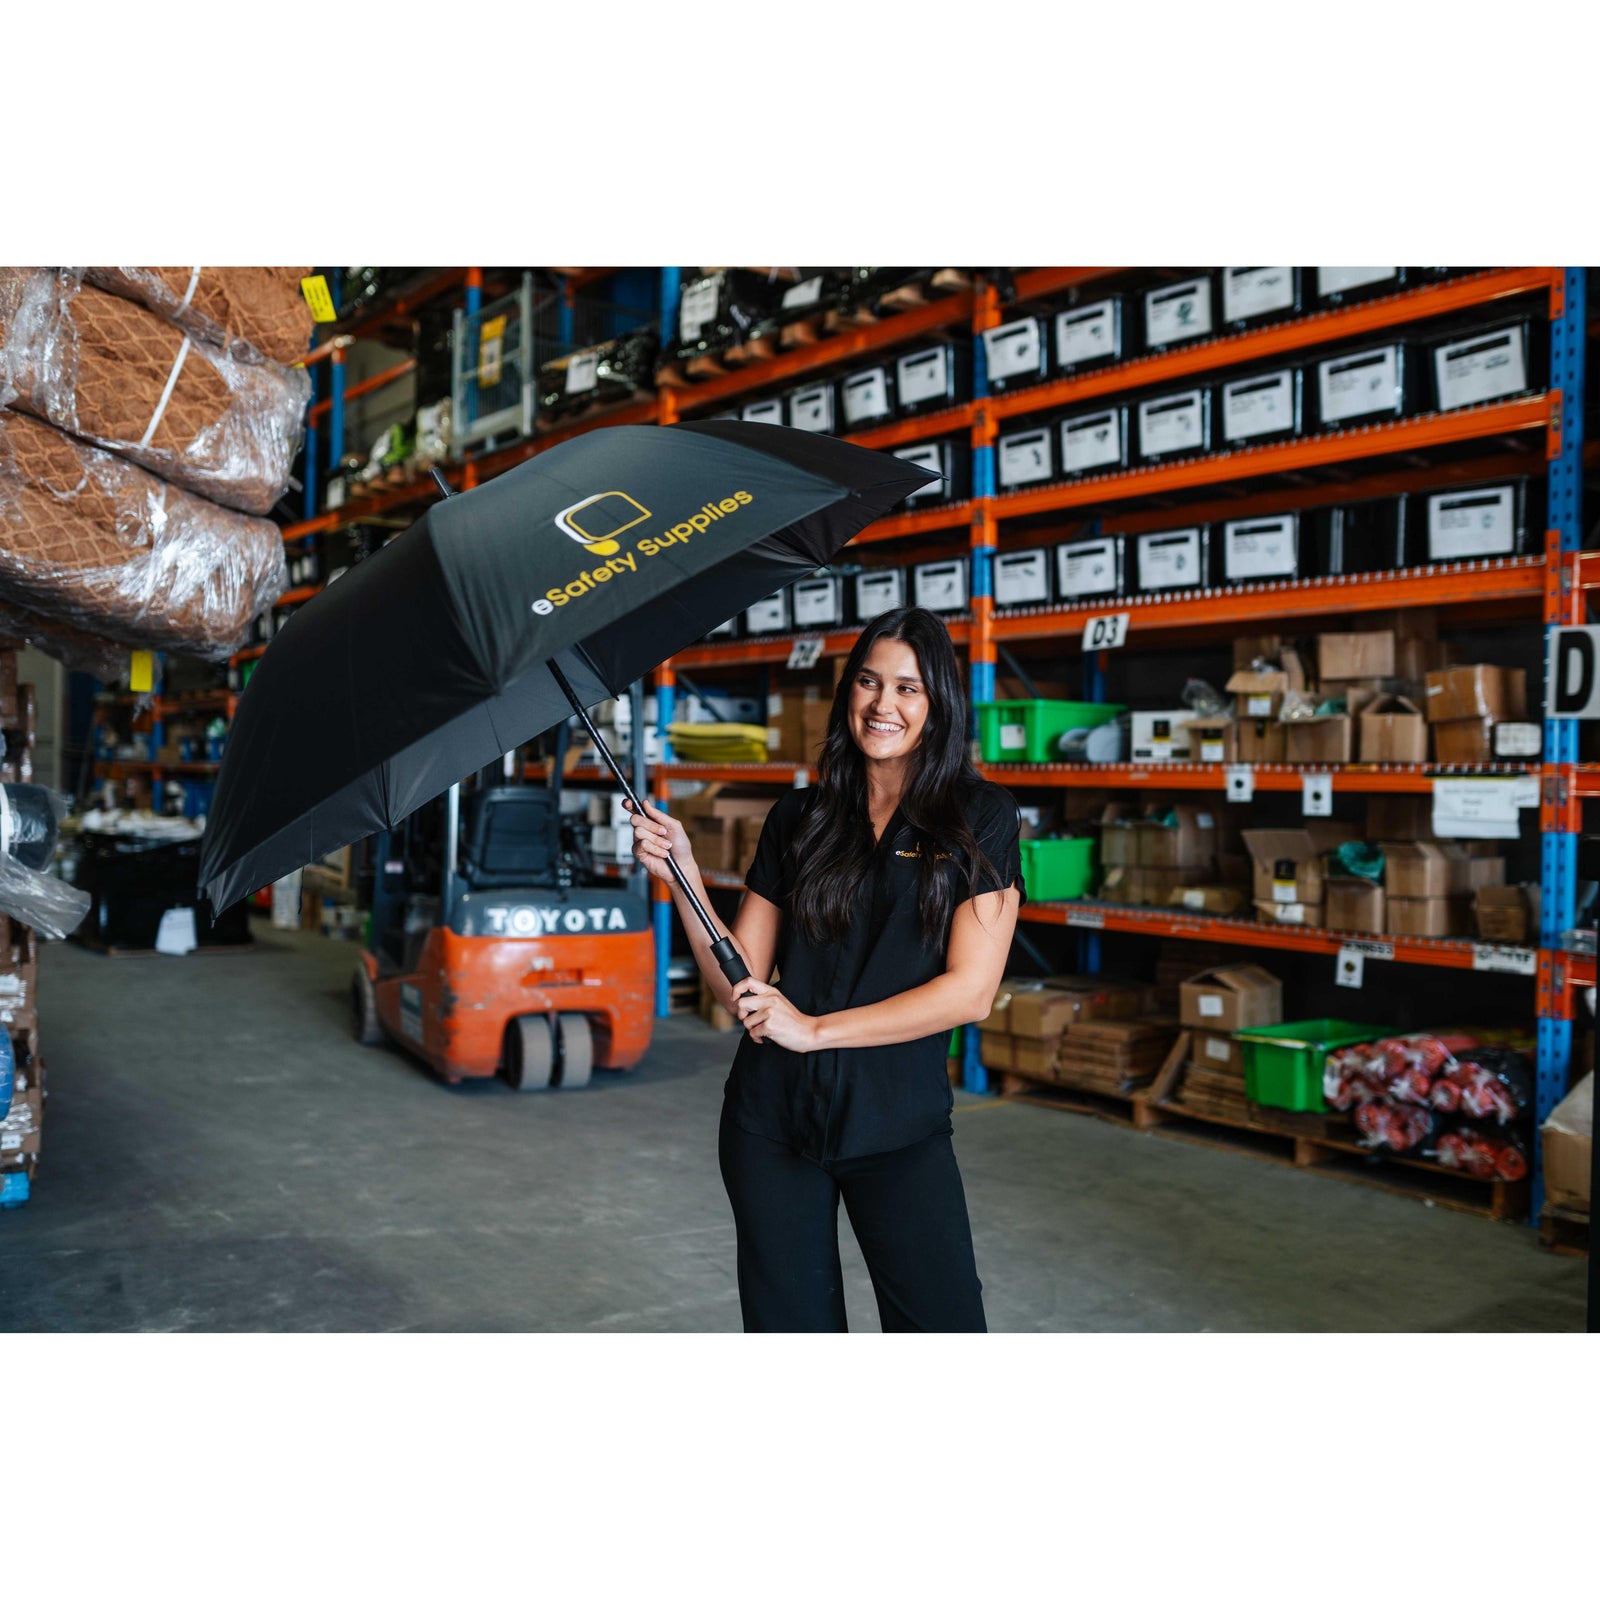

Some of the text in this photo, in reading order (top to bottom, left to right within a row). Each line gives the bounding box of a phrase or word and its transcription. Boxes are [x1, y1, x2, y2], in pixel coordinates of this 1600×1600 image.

[531, 490, 754, 615] eSafety Supplies
[1092, 617, 1118, 645] D3
[1554, 631, 1595, 712] D
[486, 906, 628, 932] TOYOTA
